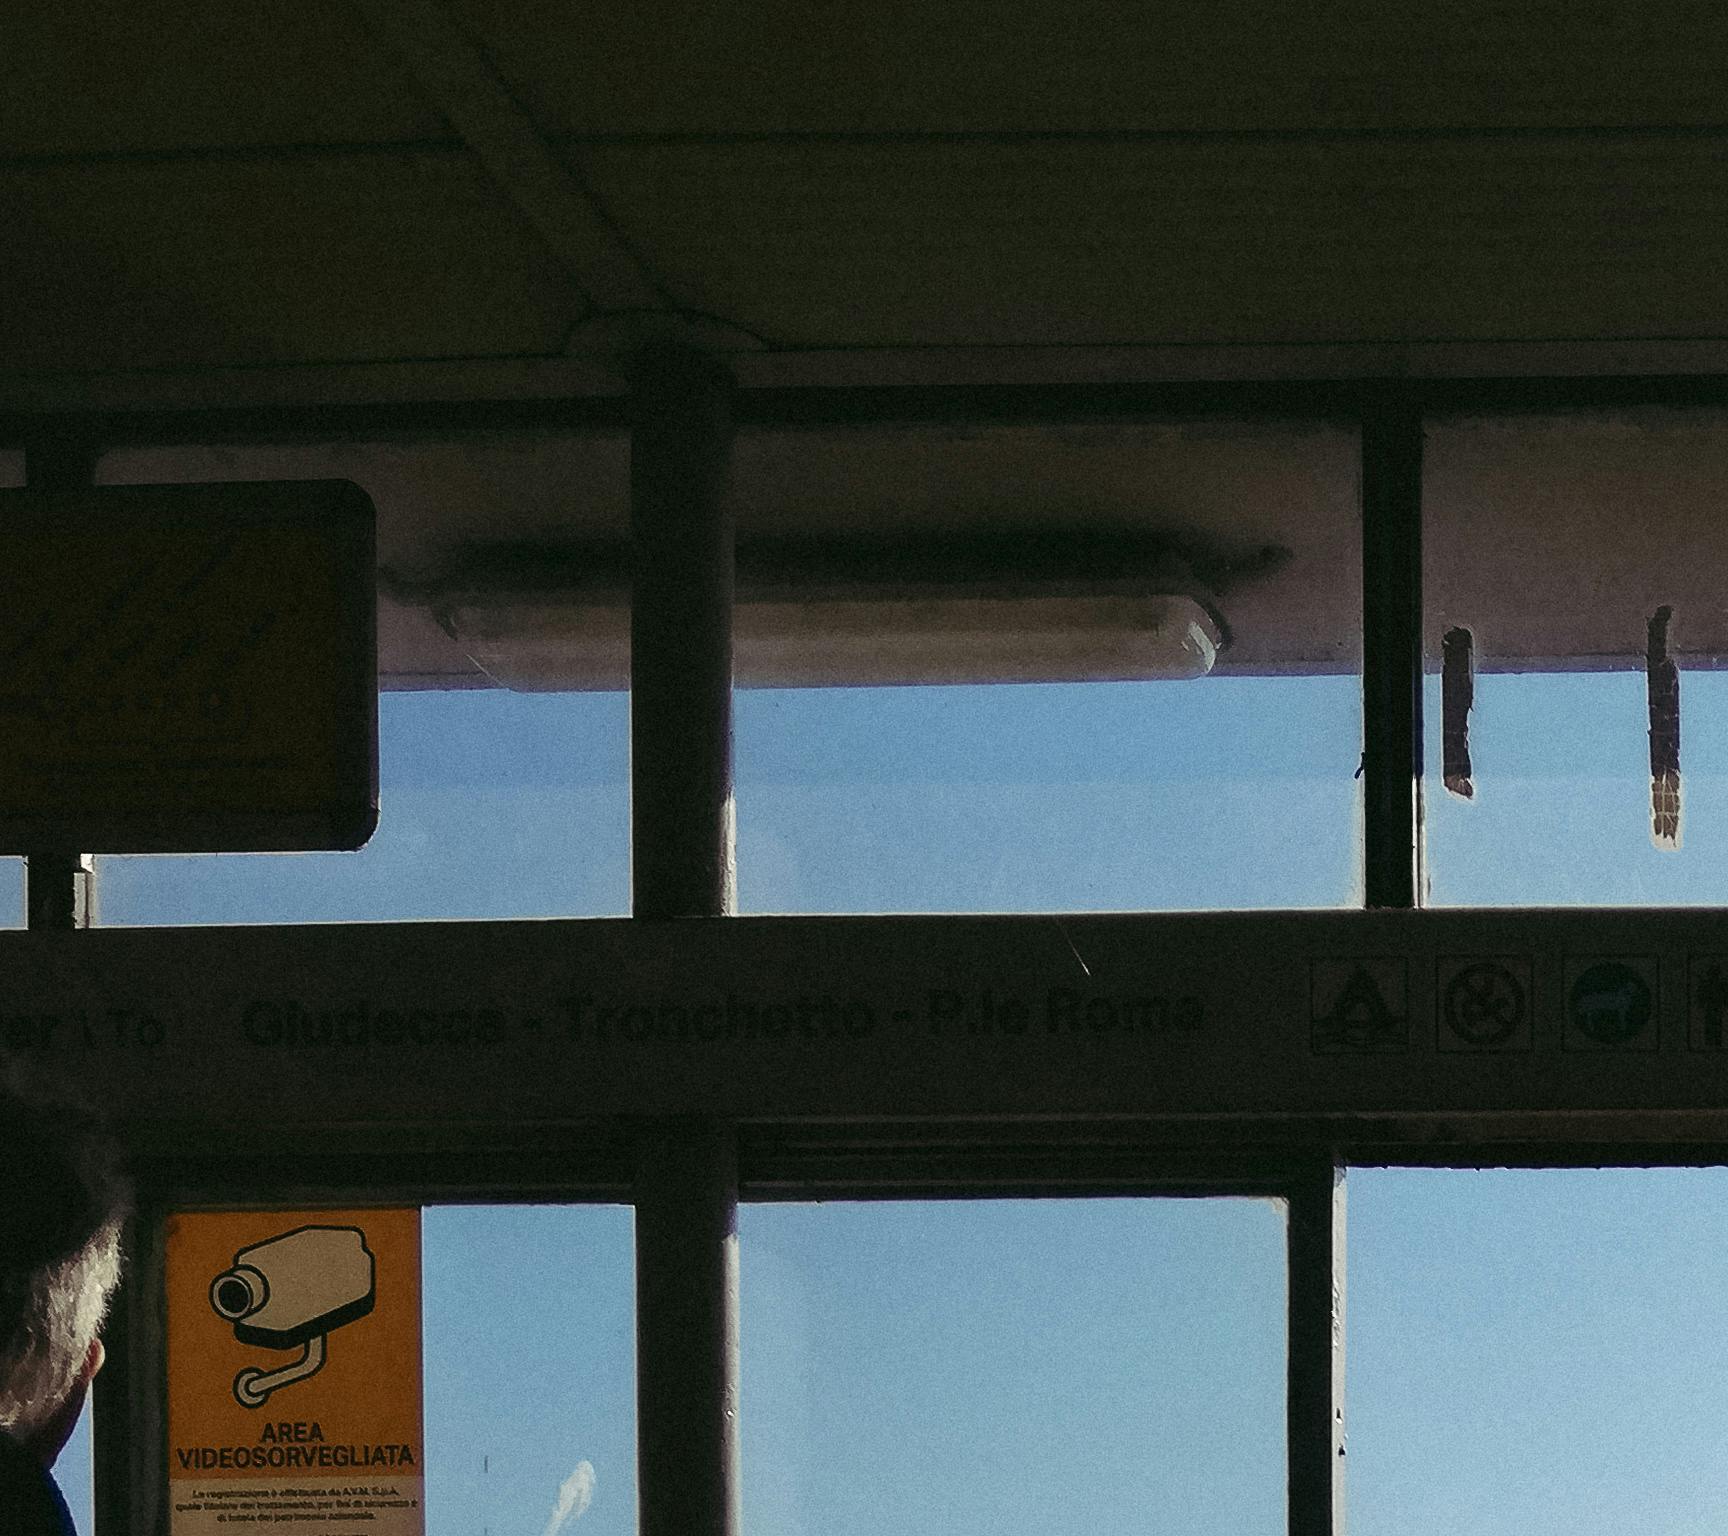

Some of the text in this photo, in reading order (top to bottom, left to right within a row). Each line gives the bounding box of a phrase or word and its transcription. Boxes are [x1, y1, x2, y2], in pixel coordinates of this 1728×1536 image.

[0, 1012, 61, 1050] er
[107, 1007, 167, 1049] To
[241, 998, 506, 1048] Giudecca
[557, 994, 878, 1043] Tronchetto
[927, 988, 1031, 1037] P.le
[1046, 986, 1206, 1035] Roma
[261, 1421, 324, 1443] AREA
[176, 1444, 415, 1470] VIDEOSORVEGLIATA
